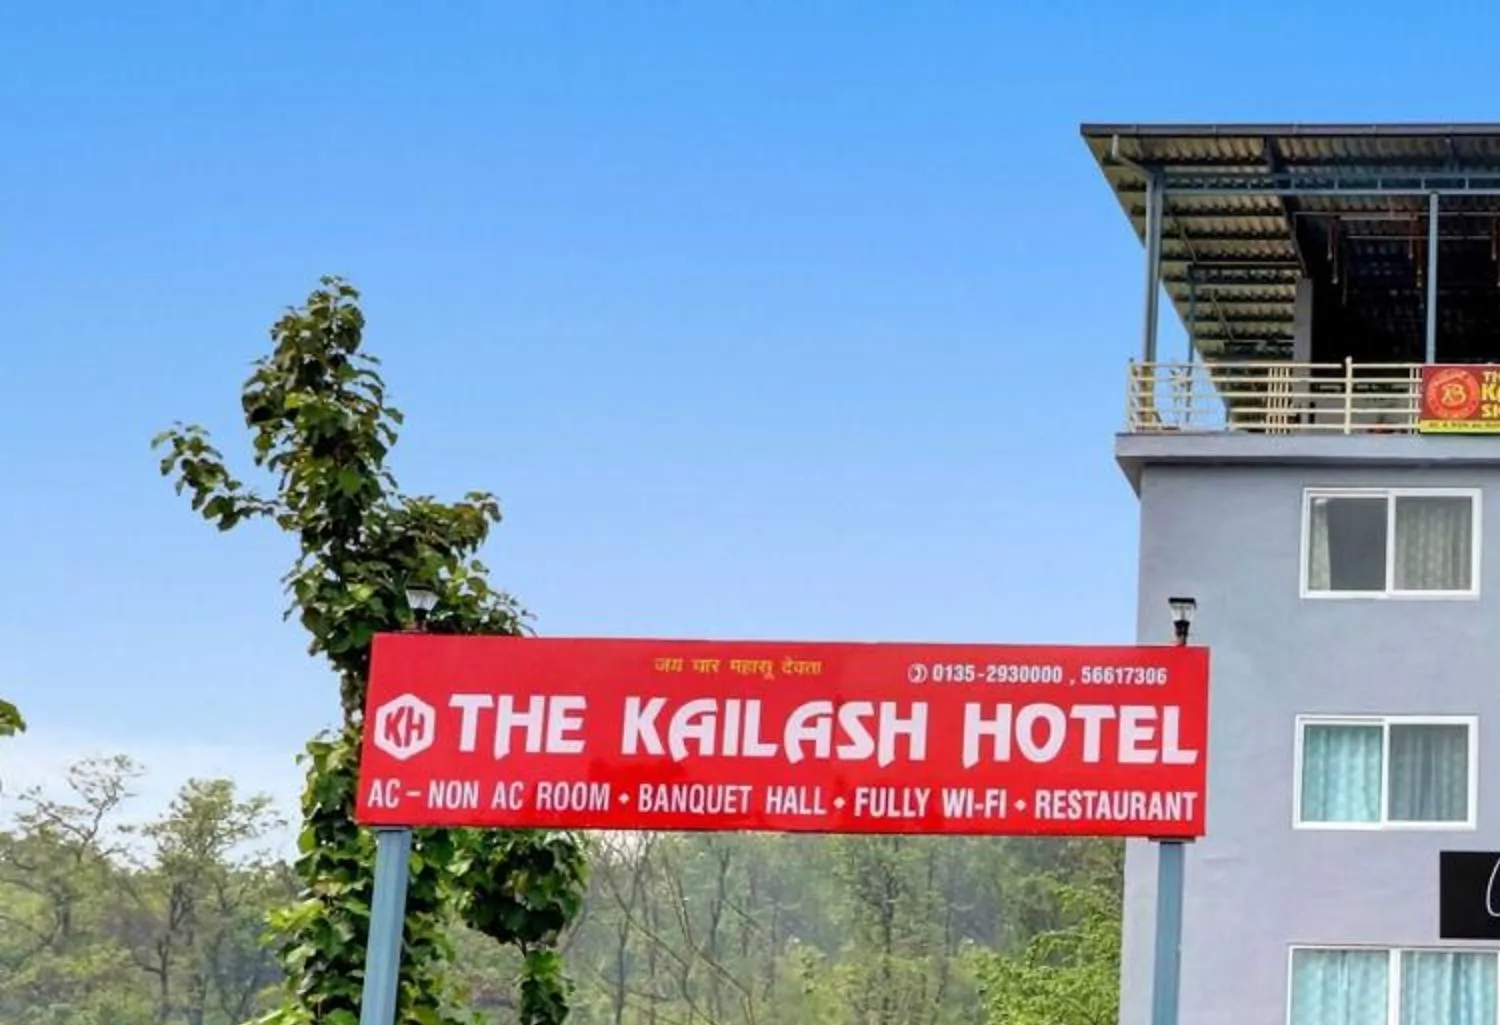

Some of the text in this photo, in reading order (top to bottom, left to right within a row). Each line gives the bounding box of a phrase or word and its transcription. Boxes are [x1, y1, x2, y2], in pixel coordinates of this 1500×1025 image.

[932, 663, 1062, 683] 0135-2930000
[1081, 667, 1168, 686] 56617306
[449, 694, 1199, 769] THE KAILASH HOTEL
[428, 780, 479, 809] NON
[492, 781, 525, 811] AC
[536, 782, 610, 811] ROOM
[638, 784, 752, 814] BANQUET
[766, 786, 826, 816] HALL
[854, 787, 931, 818] FULLY
[942, 788, 1006, 818] WI-FI
[1035, 790, 1198, 821] RESTAURANT
